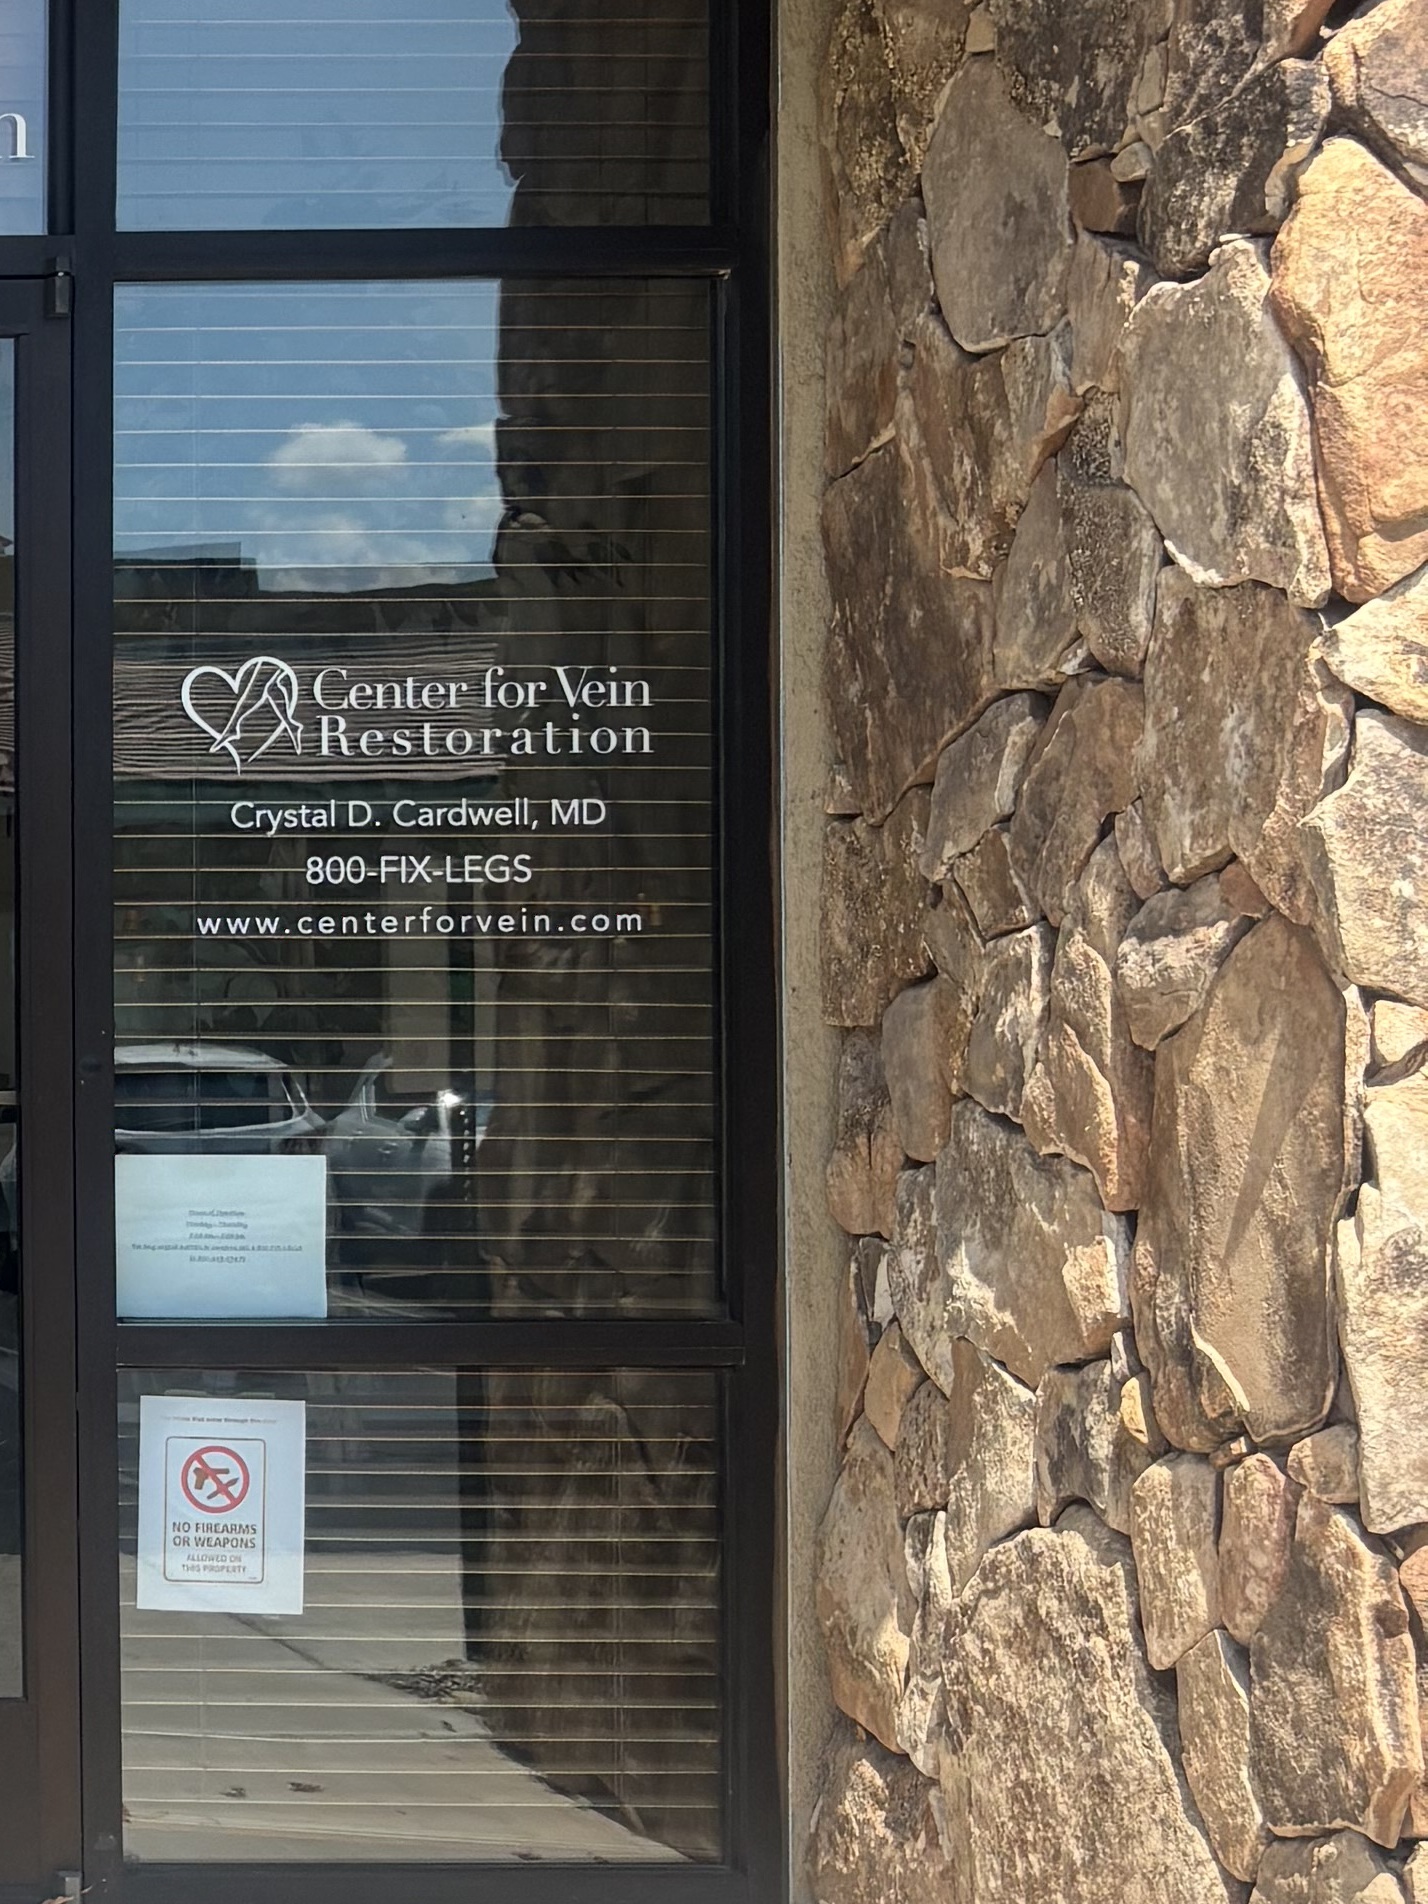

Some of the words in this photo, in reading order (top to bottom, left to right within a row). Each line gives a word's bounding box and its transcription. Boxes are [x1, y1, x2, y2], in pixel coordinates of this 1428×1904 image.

[313, 668, 468, 710] Center
[481, 665, 547, 709] for
[549, 666, 652, 709] Vein
[316, 714, 655, 757] Restoration
[230, 799, 336, 837] Crystal
[348, 801, 381, 827] D.
[392, 798, 538, 830] Cardwell,
[550, 799, 606, 827] MD
[305, 855, 533, 885] 800-FIX-LEGS
[197, 907, 643, 935] www.centerforvein.com
[172, 1522, 191, 1533] NO
[195, 1523, 257, 1534] FIREARMS
[173, 1536, 191, 1547] OR
[194, 1536, 256, 1548] WEAPONS
[186, 1554, 227, 1562] ALLOWED
